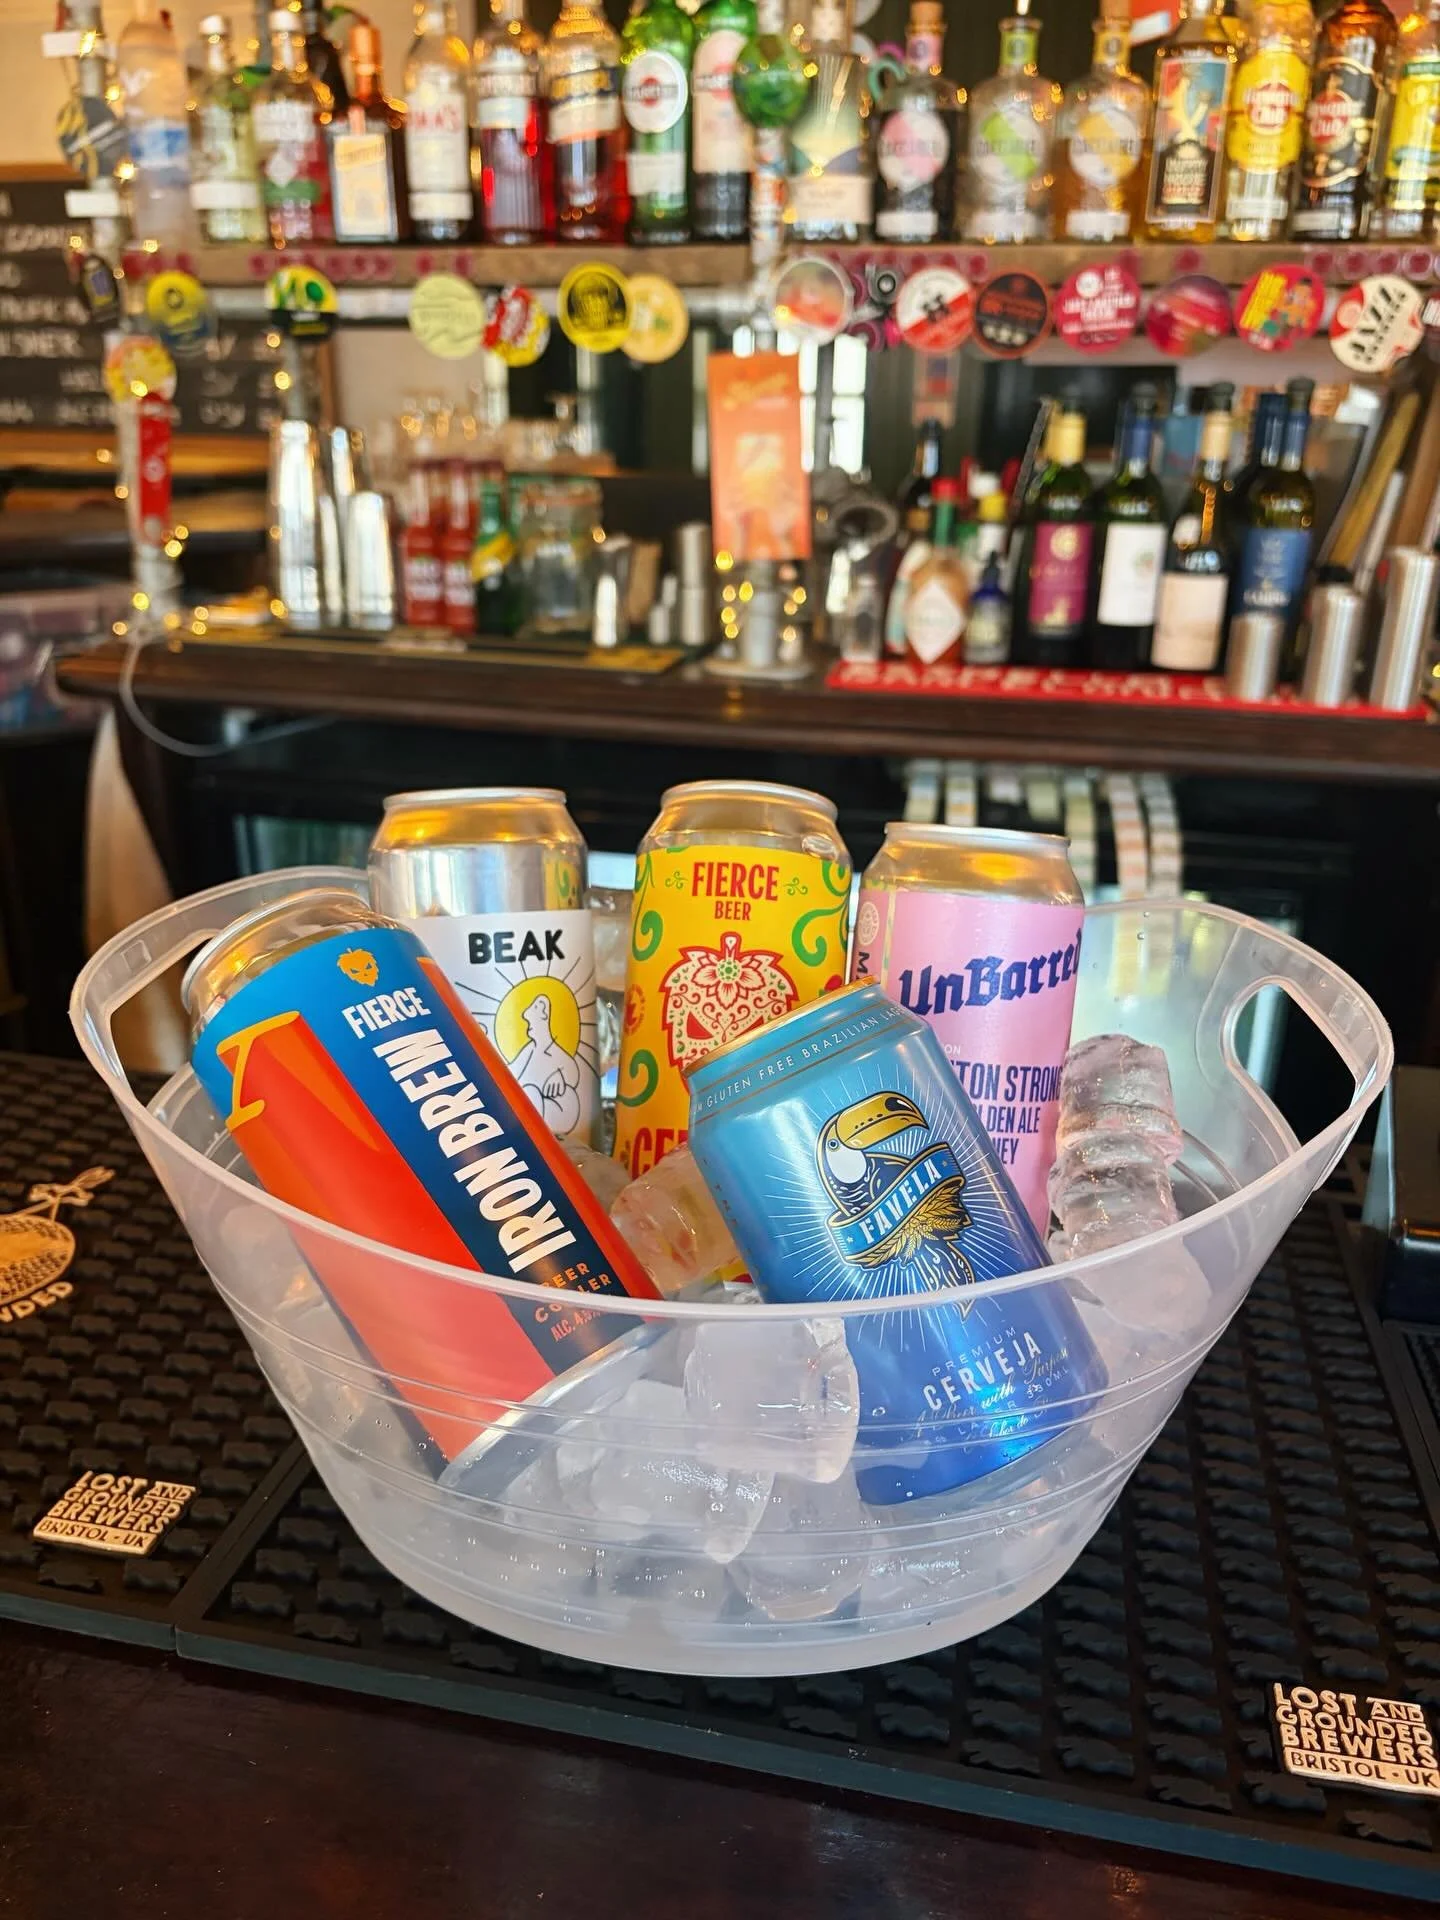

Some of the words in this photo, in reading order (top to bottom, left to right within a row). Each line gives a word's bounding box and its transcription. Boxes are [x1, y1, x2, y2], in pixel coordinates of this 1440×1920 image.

[692, 861, 779, 902] FIERCE
[714, 900, 751, 921] BEER
[468, 929, 565, 964] BEAK
[342, 987, 431, 1039] FIERCE
[706, 1076, 751, 1108] GLUTEN
[758, 1055, 794, 1081] FREE
[803, 1015, 879, 1059] BRAZILIAN
[372, 1028, 505, 1159] BREW
[1017, 1106, 1041, 1133] ALE
[453, 1146, 577, 1274] IRON
[859, 1158, 942, 1245] FAVELA
[923, 1331, 1042, 1410] CERVEJA
[932, 1327, 1017, 1376] PREMIUM
[981, 1372, 1016, 1410] with
[64, 1486, 181, 1519] GROUNDED
[75, 1470, 149, 1497] LOST
[146, 1485, 194, 1501] AND
[38, 1519, 107, 1542] BRISTOL
[122, 1533, 149, 1549] UK
[47, 1500, 170, 1534] BREWERS
[1273, 1682, 1357, 1717] LOST
[1371, 1700, 1425, 1723] AND
[1276, 1704, 1434, 1747] GROUNDED
[1280, 1723, 1439, 1770] BREWERS
[1290, 1751, 1387, 1781] BRISTOL
[1404, 1768, 1438, 1788] UK
